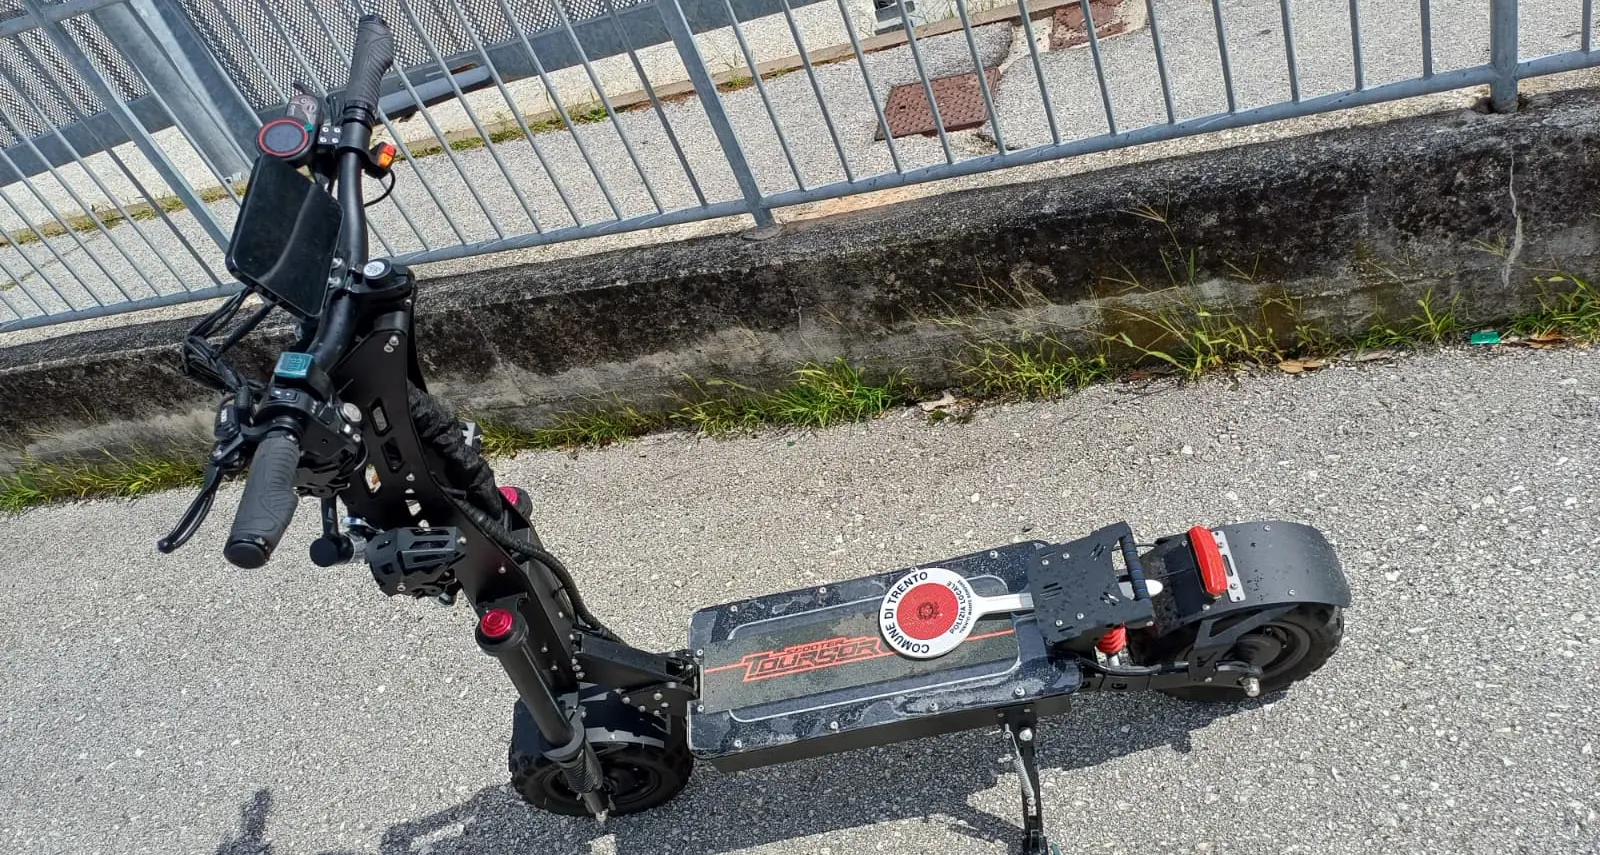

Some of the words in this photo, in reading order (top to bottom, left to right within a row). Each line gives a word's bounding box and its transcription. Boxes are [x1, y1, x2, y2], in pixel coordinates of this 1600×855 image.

[887, 571, 928, 604] TRENTO
[946, 580, 966, 605] LOCALE
[884, 608, 894, 620] DI
[949, 606, 966, 634] POLIZIA
[786, 638, 846, 653] SCOOTER
[885, 622, 930, 654] COMUNE
